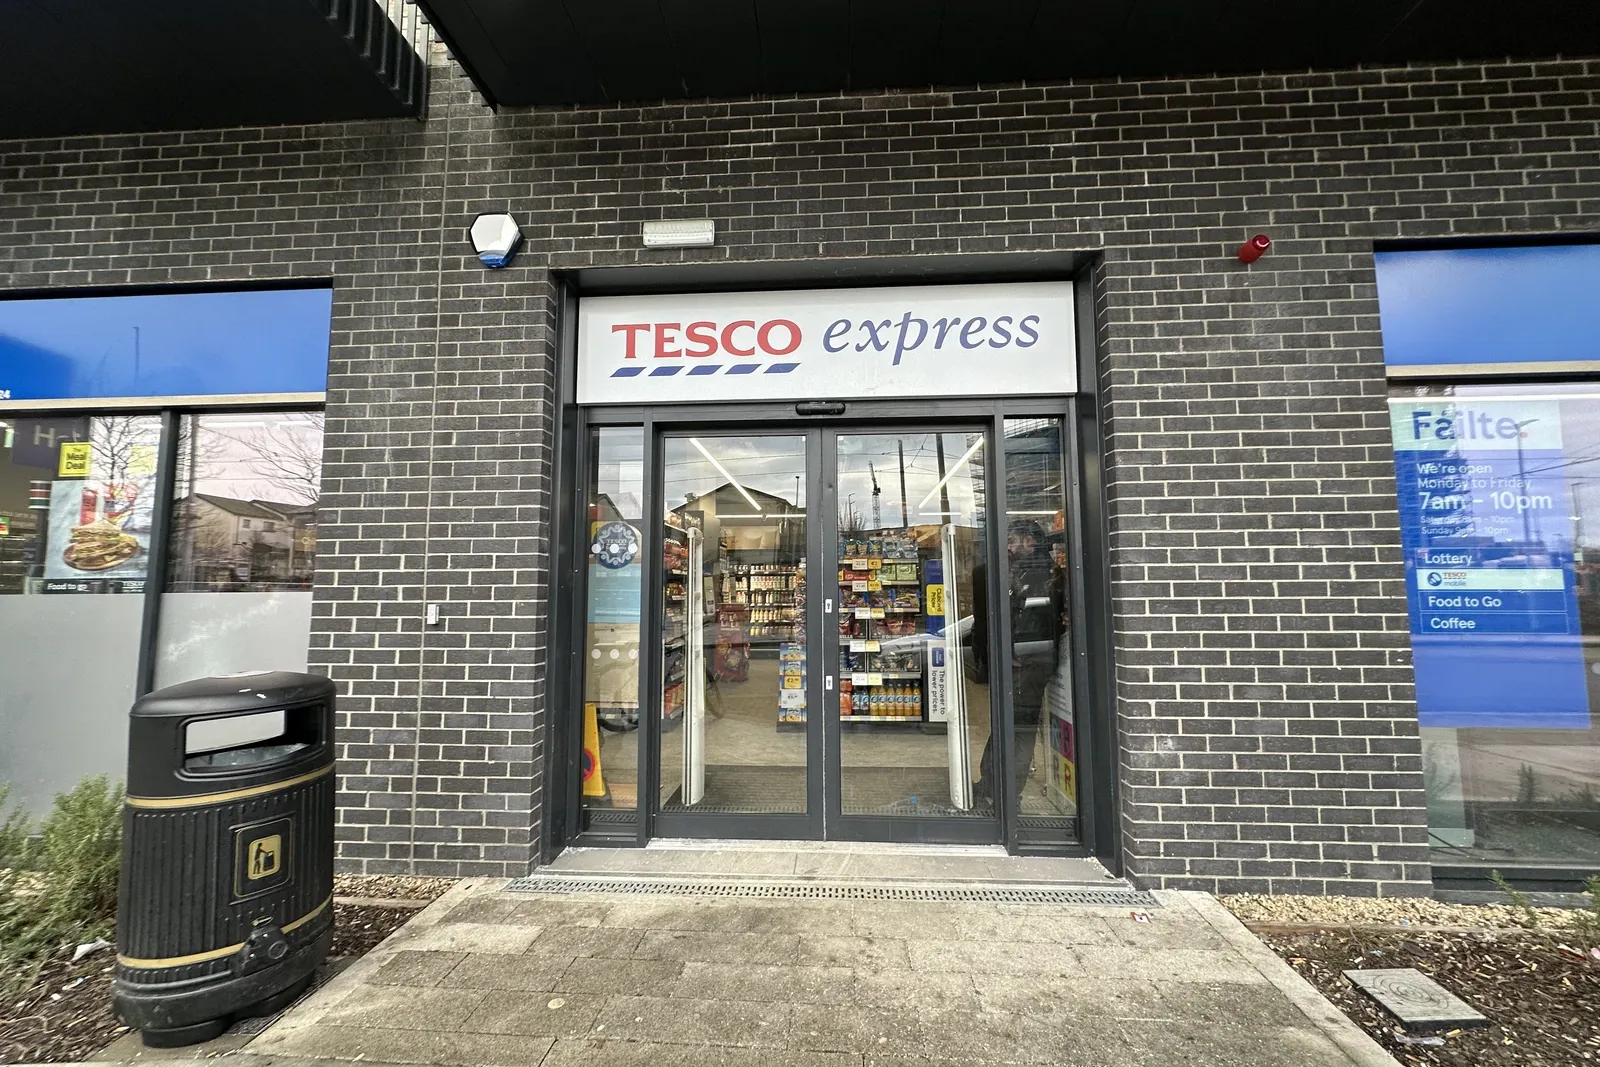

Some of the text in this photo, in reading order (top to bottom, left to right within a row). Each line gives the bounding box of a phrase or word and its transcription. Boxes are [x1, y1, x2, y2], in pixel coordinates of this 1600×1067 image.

[611, 311, 1041, 366] TESCO express
[66, 452, 88, 461] Meal
[66, 461, 86, 470] Deal
[1459, 464, 1493, 476] open
[1417, 478, 1532, 490] Monday to Friday
[1418, 491, 1467, 510] 7am
[1490, 491, 1553, 514] 10pm
[1421, 526, 1453, 536] Sunday
[1425, 553, 1473, 567] Lottery
[1428, 595, 1502, 608] Food to Go
[1430, 617, 1476, 629] Coffee
[939, 707, 946, 715] to
